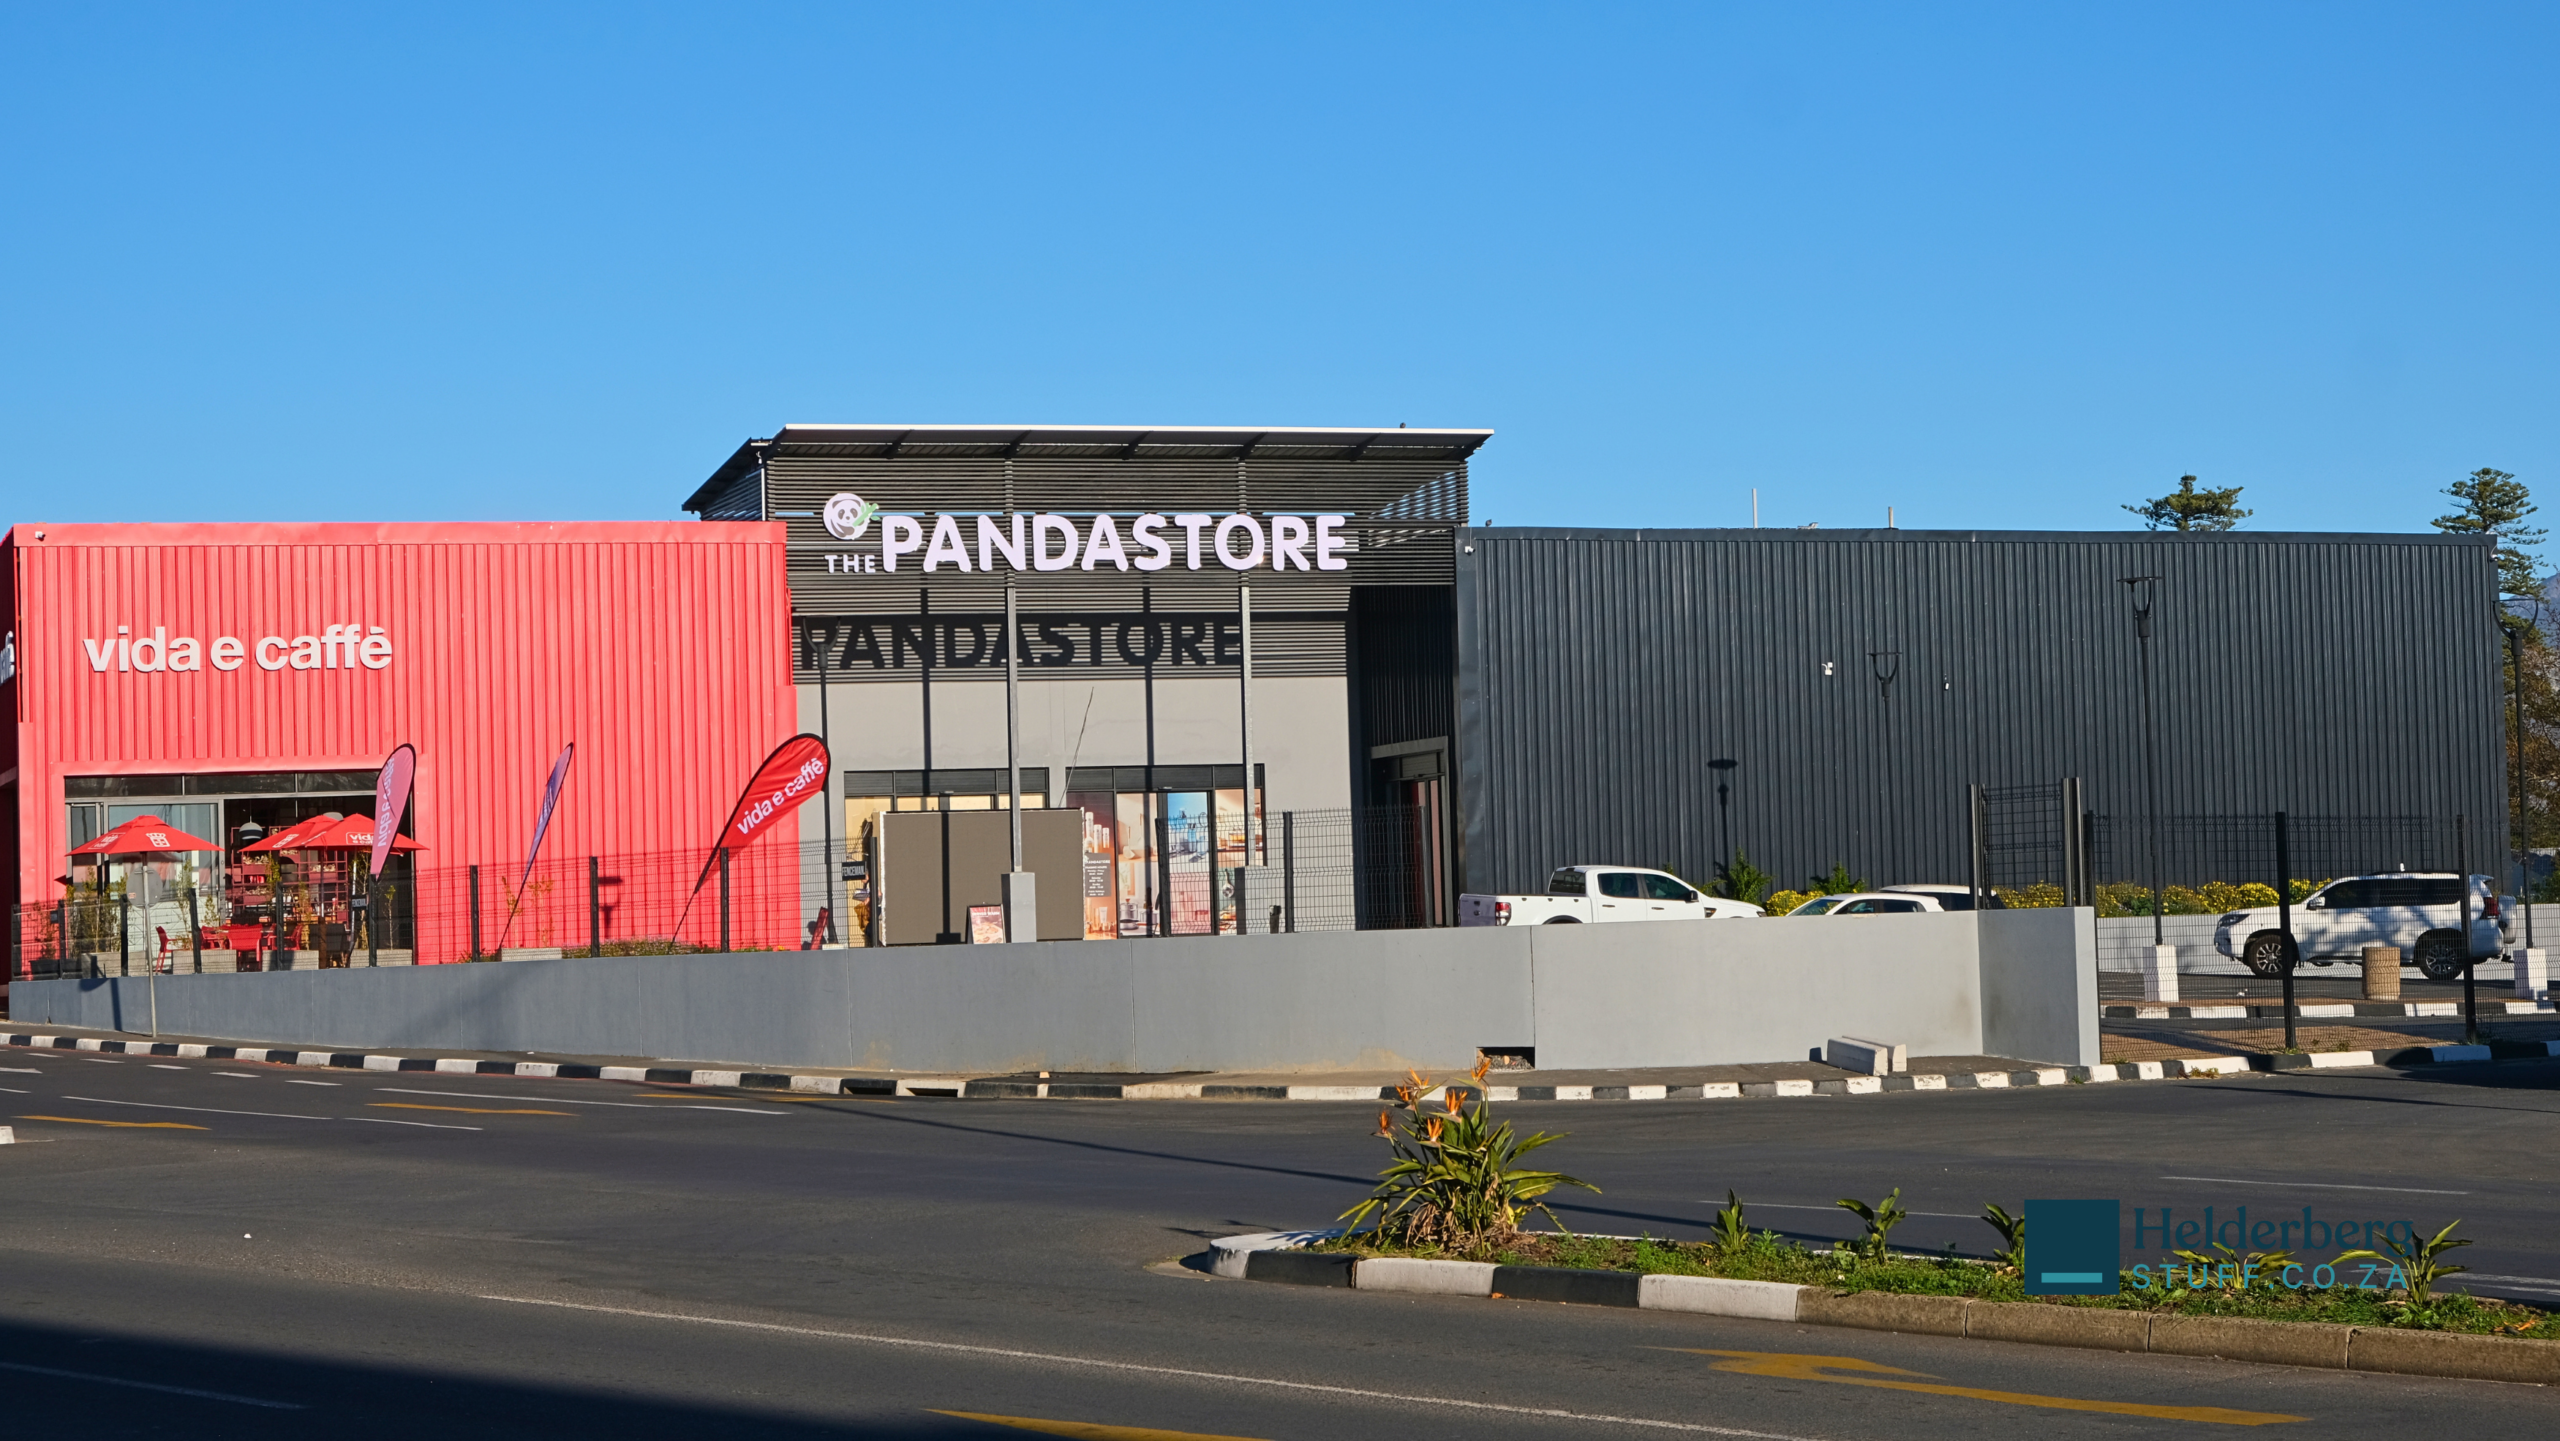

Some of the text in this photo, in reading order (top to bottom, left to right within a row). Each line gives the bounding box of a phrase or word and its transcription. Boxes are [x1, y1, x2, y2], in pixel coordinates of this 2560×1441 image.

[824, 513, 1350, 574] THE PANDASTORE
[83, 626, 201, 672] vida
[210, 636, 245, 671] e
[737, 802, 774, 835] vida
[771, 791, 785, 806] e
